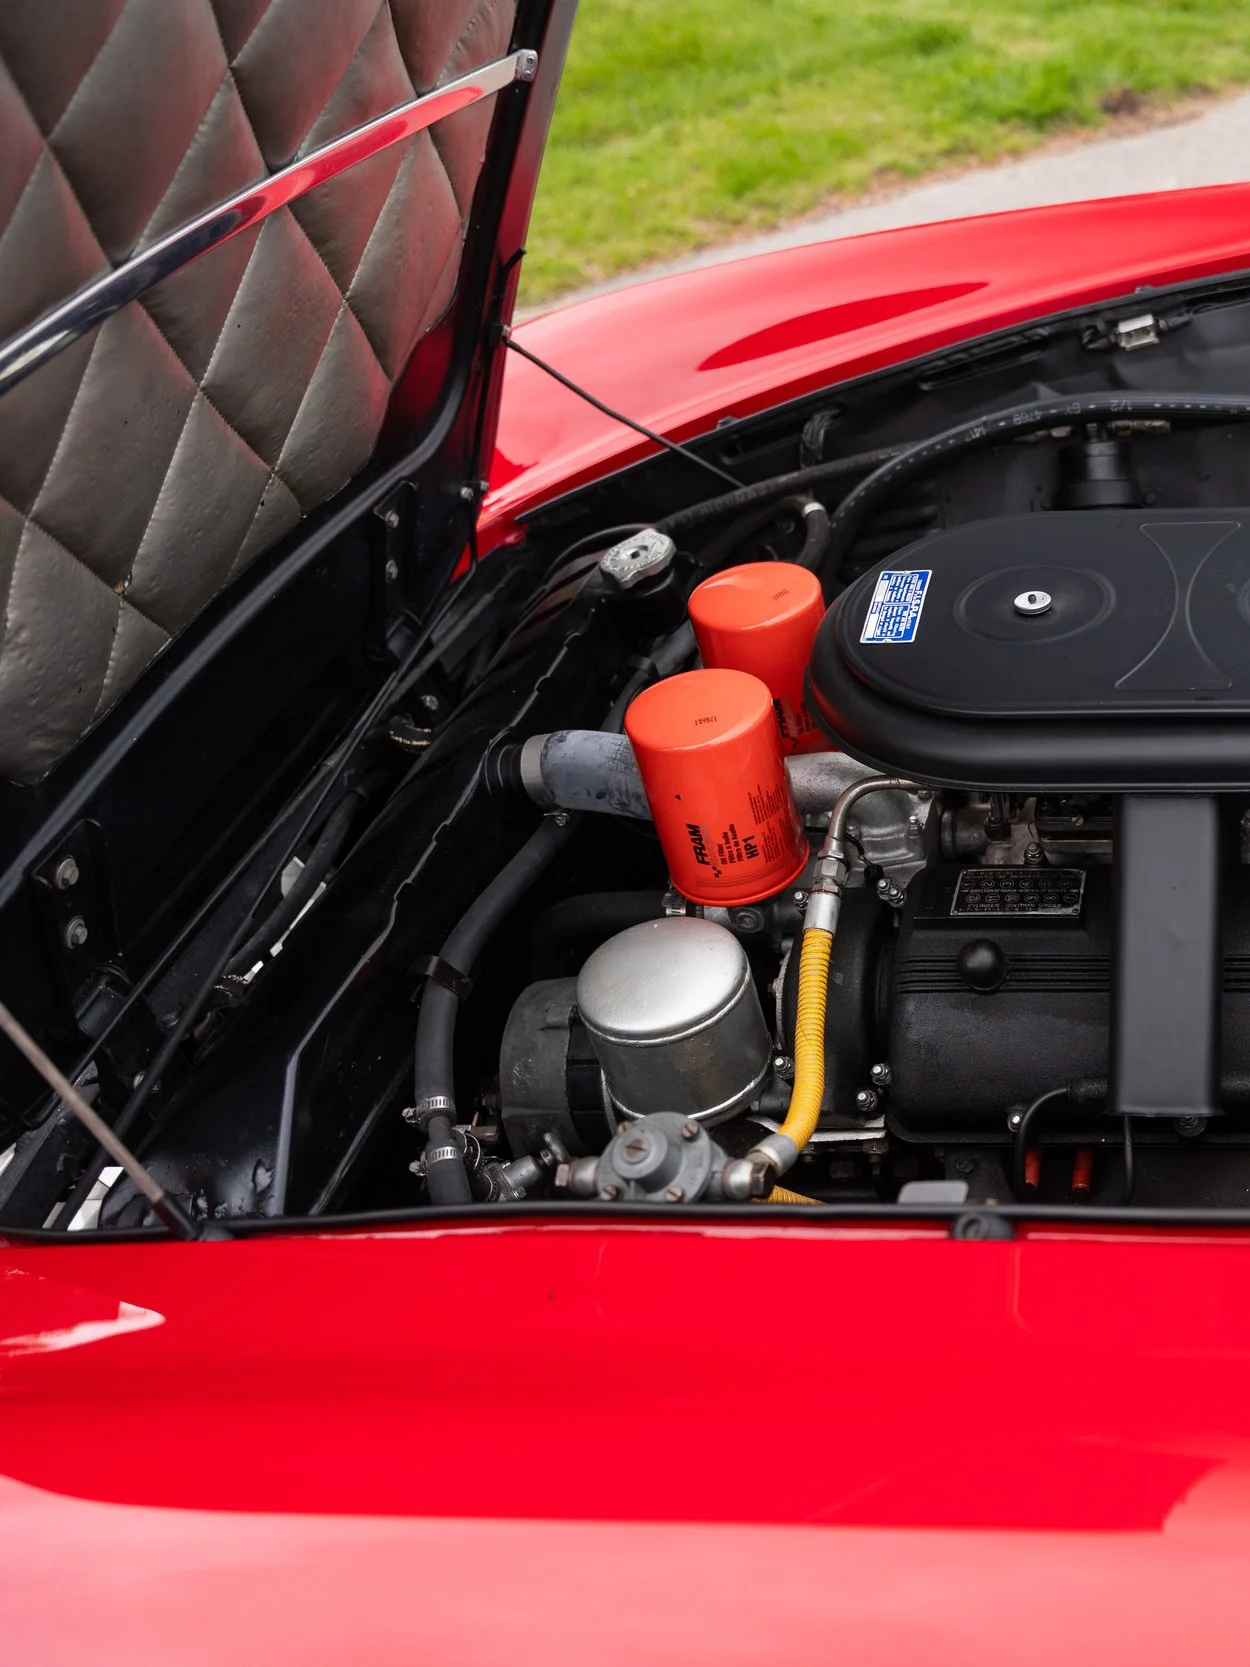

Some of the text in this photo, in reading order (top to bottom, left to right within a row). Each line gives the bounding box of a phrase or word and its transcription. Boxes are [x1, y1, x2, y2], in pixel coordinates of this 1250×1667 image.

[1109, 399, 1133, 412] 1/2
[686, 823, 710, 865] FRAM
[742, 835, 760, 859] HP1
[720, 857, 728, 865] Oil
